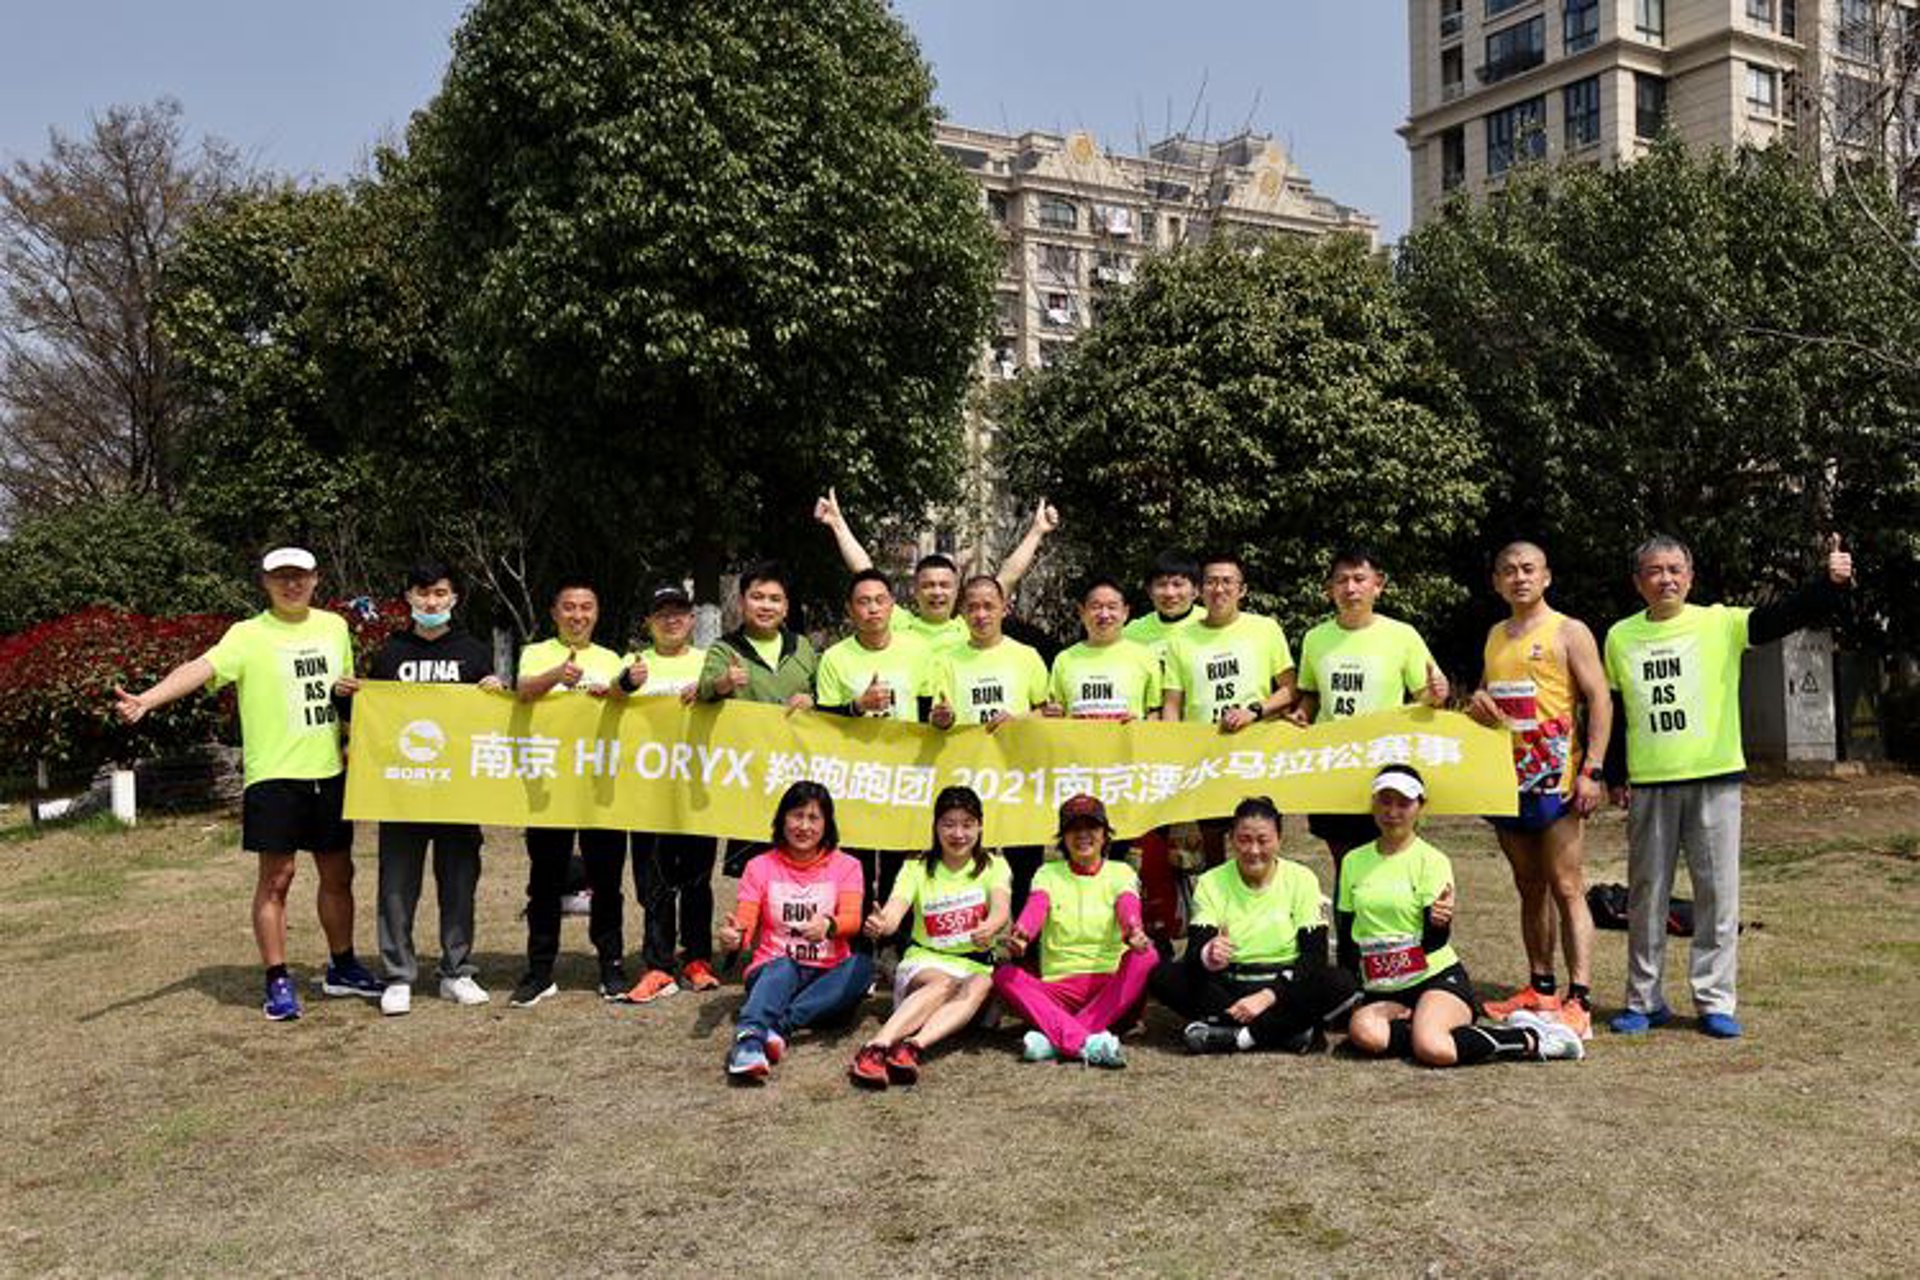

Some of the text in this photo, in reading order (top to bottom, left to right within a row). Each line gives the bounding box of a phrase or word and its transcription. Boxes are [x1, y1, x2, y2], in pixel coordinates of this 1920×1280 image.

[294, 655, 328, 678] RUN
[1206, 658, 1240, 681] RUN
[1643, 658, 1681, 680] RUN
[304, 681, 326, 701] AS
[1081, 683, 1114, 700] RUN
[1215, 683, 1235, 701] AS
[1331, 673, 1364, 691] RUN
[972, 685, 1004, 705] RUN
[1652, 684, 1675, 705] AS
[1334, 697, 1355, 715] AS
[1660, 709, 1686, 732] DO
[469, 732, 560, 779] 南京
[573, 738, 621, 777] HI
[635, 741, 752, 789] ORYX
